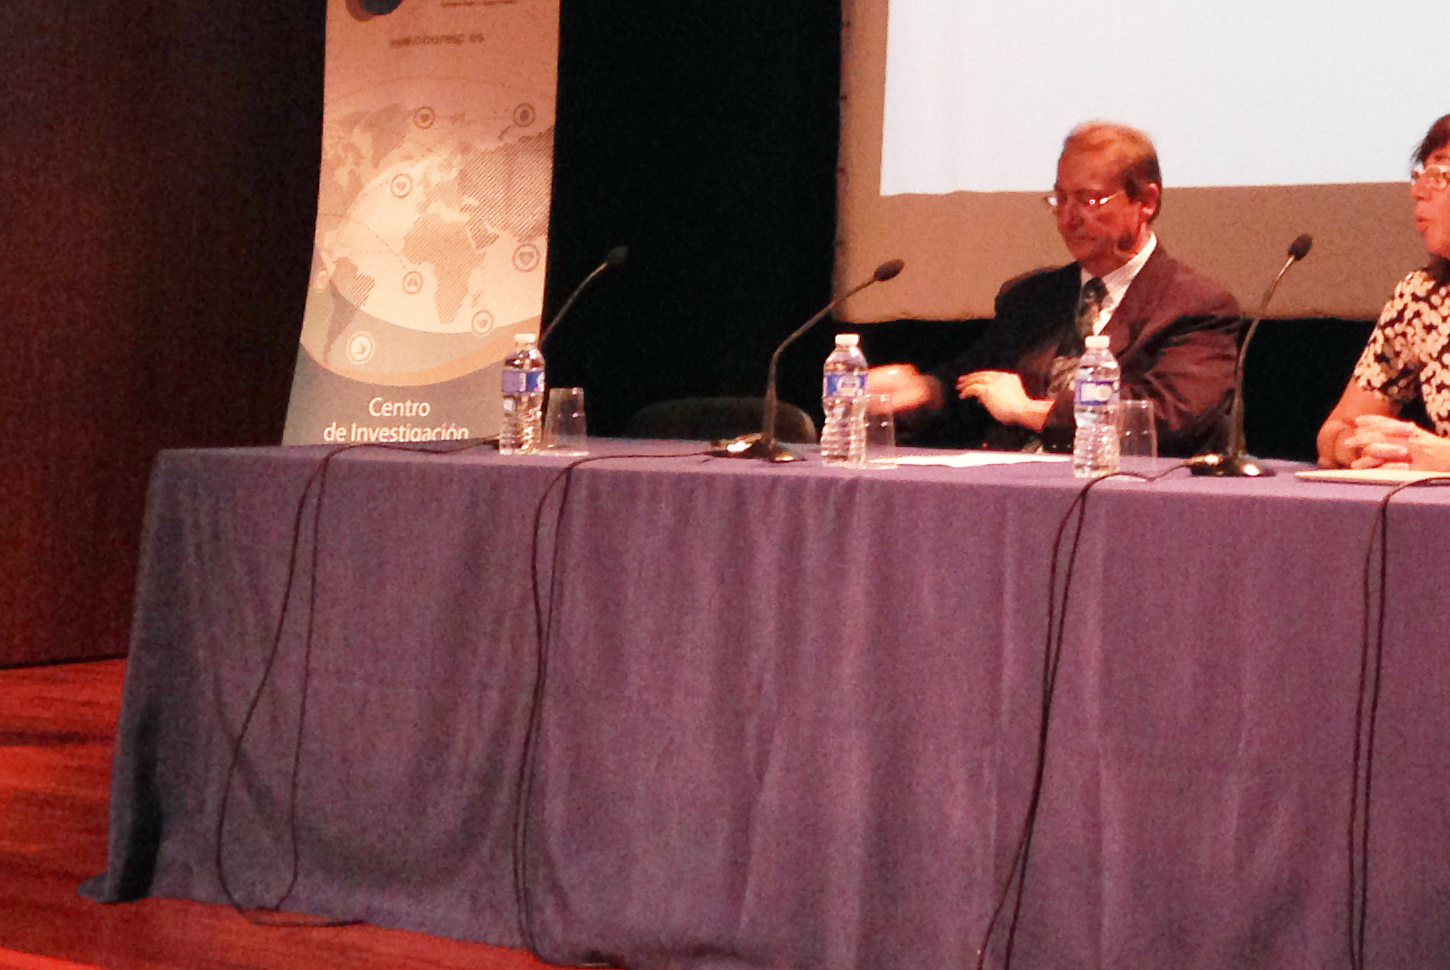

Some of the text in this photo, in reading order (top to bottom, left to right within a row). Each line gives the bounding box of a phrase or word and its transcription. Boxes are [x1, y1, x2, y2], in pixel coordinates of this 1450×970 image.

[368, 396, 432, 417] Centro
[323, 422, 469, 442] de Investigación
